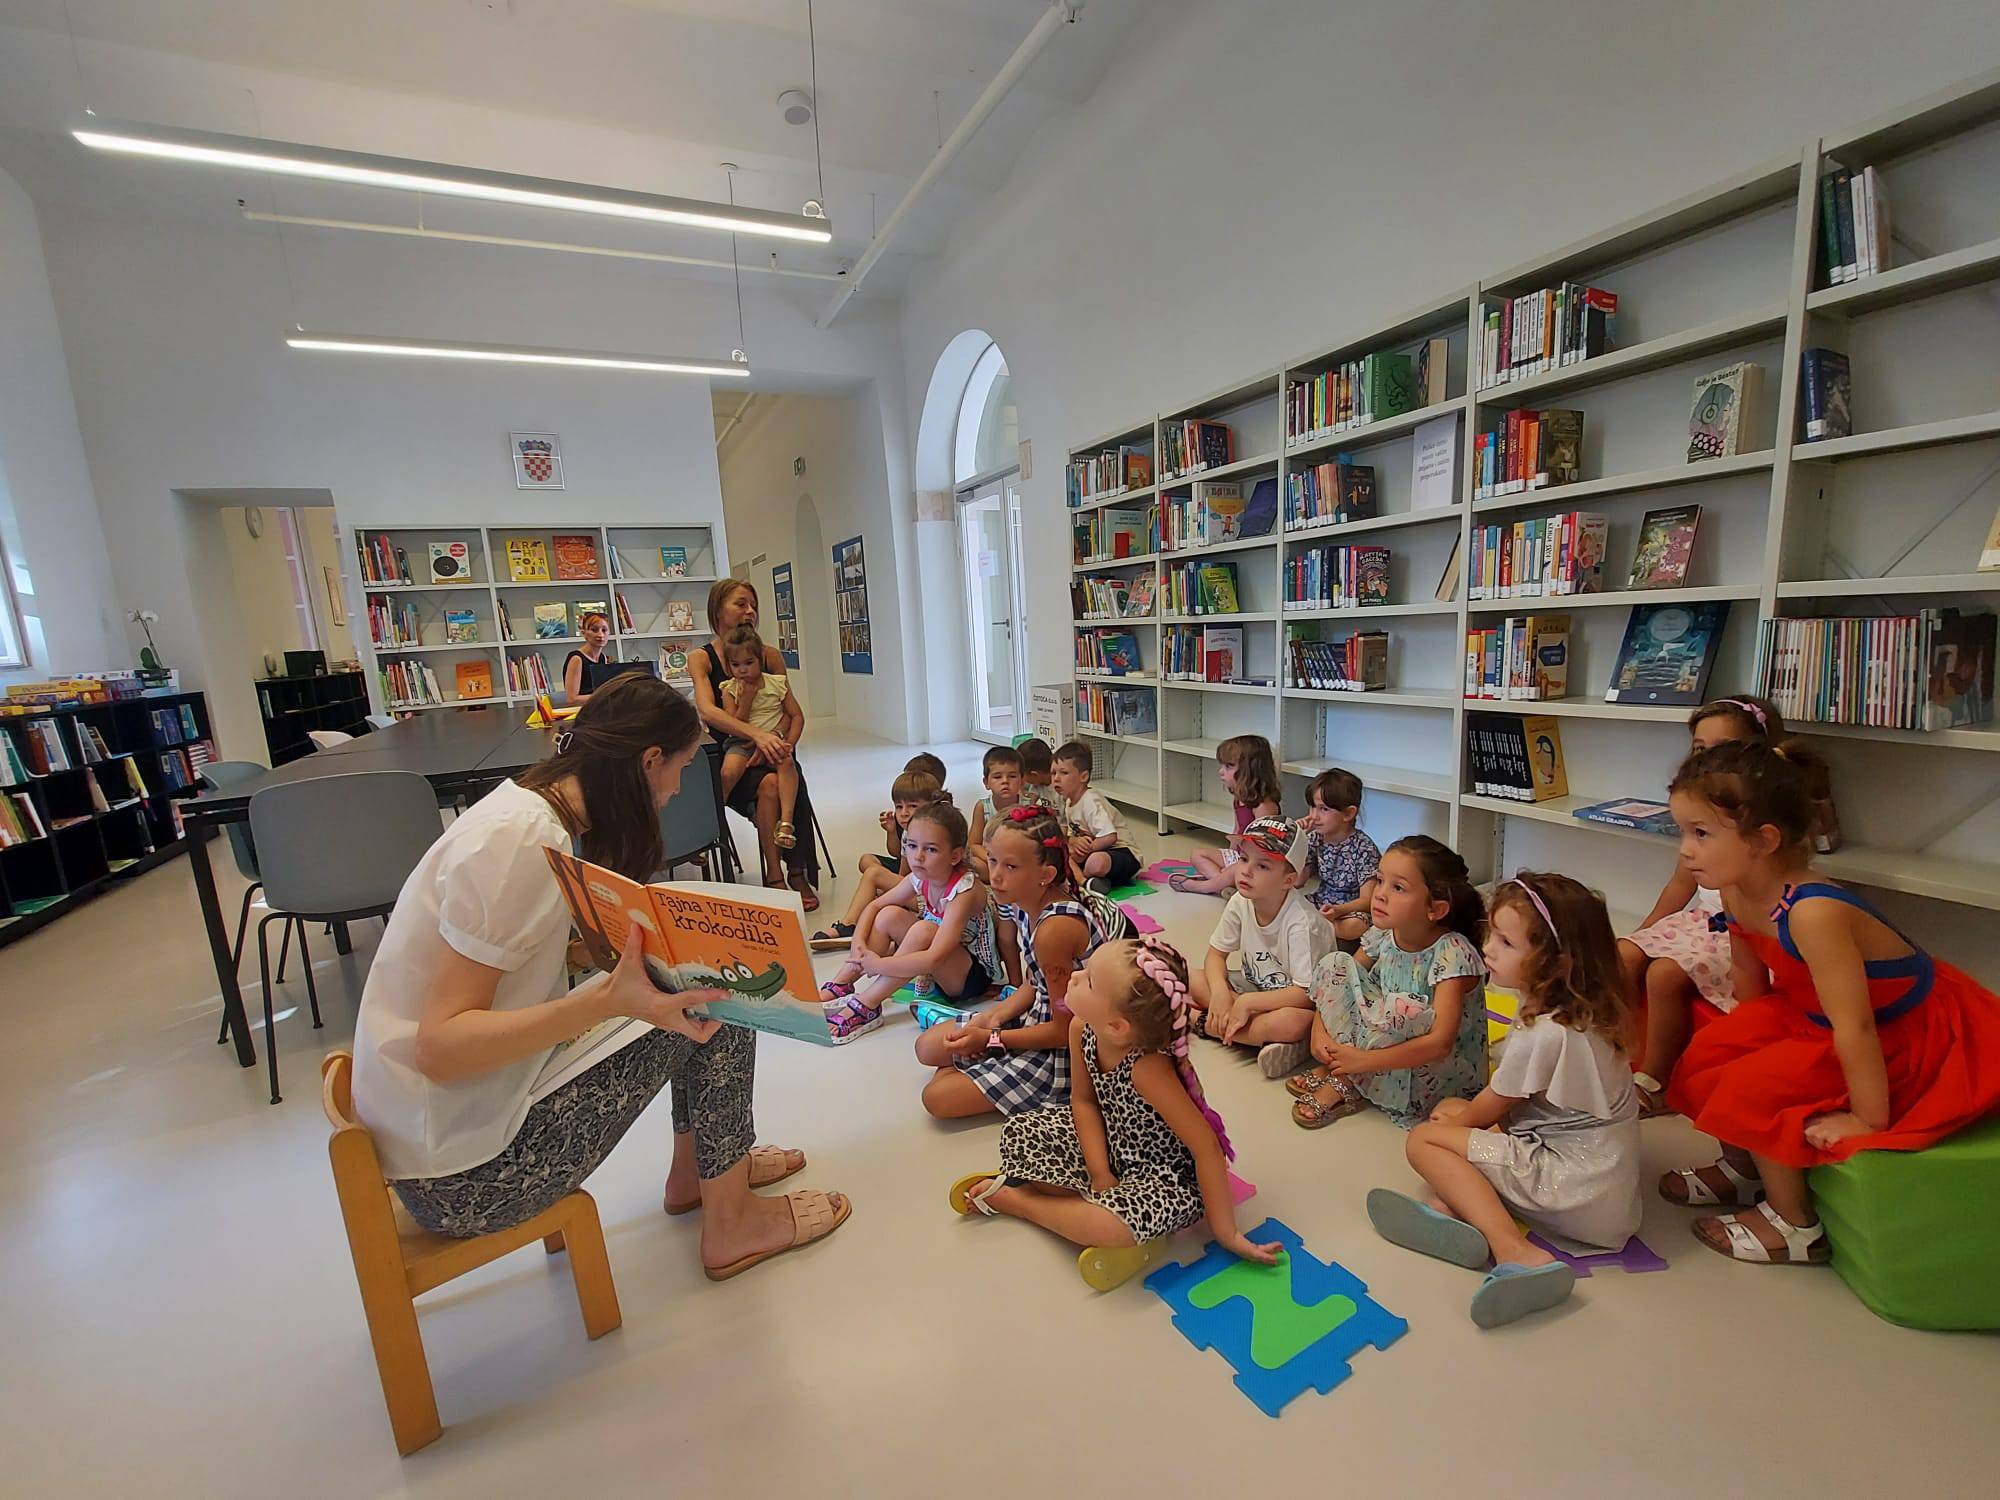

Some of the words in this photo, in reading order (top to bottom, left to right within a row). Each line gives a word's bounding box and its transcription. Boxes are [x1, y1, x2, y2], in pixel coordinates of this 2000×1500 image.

[655, 891, 703, 914] Tajna
[706, 901, 783, 929] VELIKOG
[668, 908, 779, 947] krokodila
